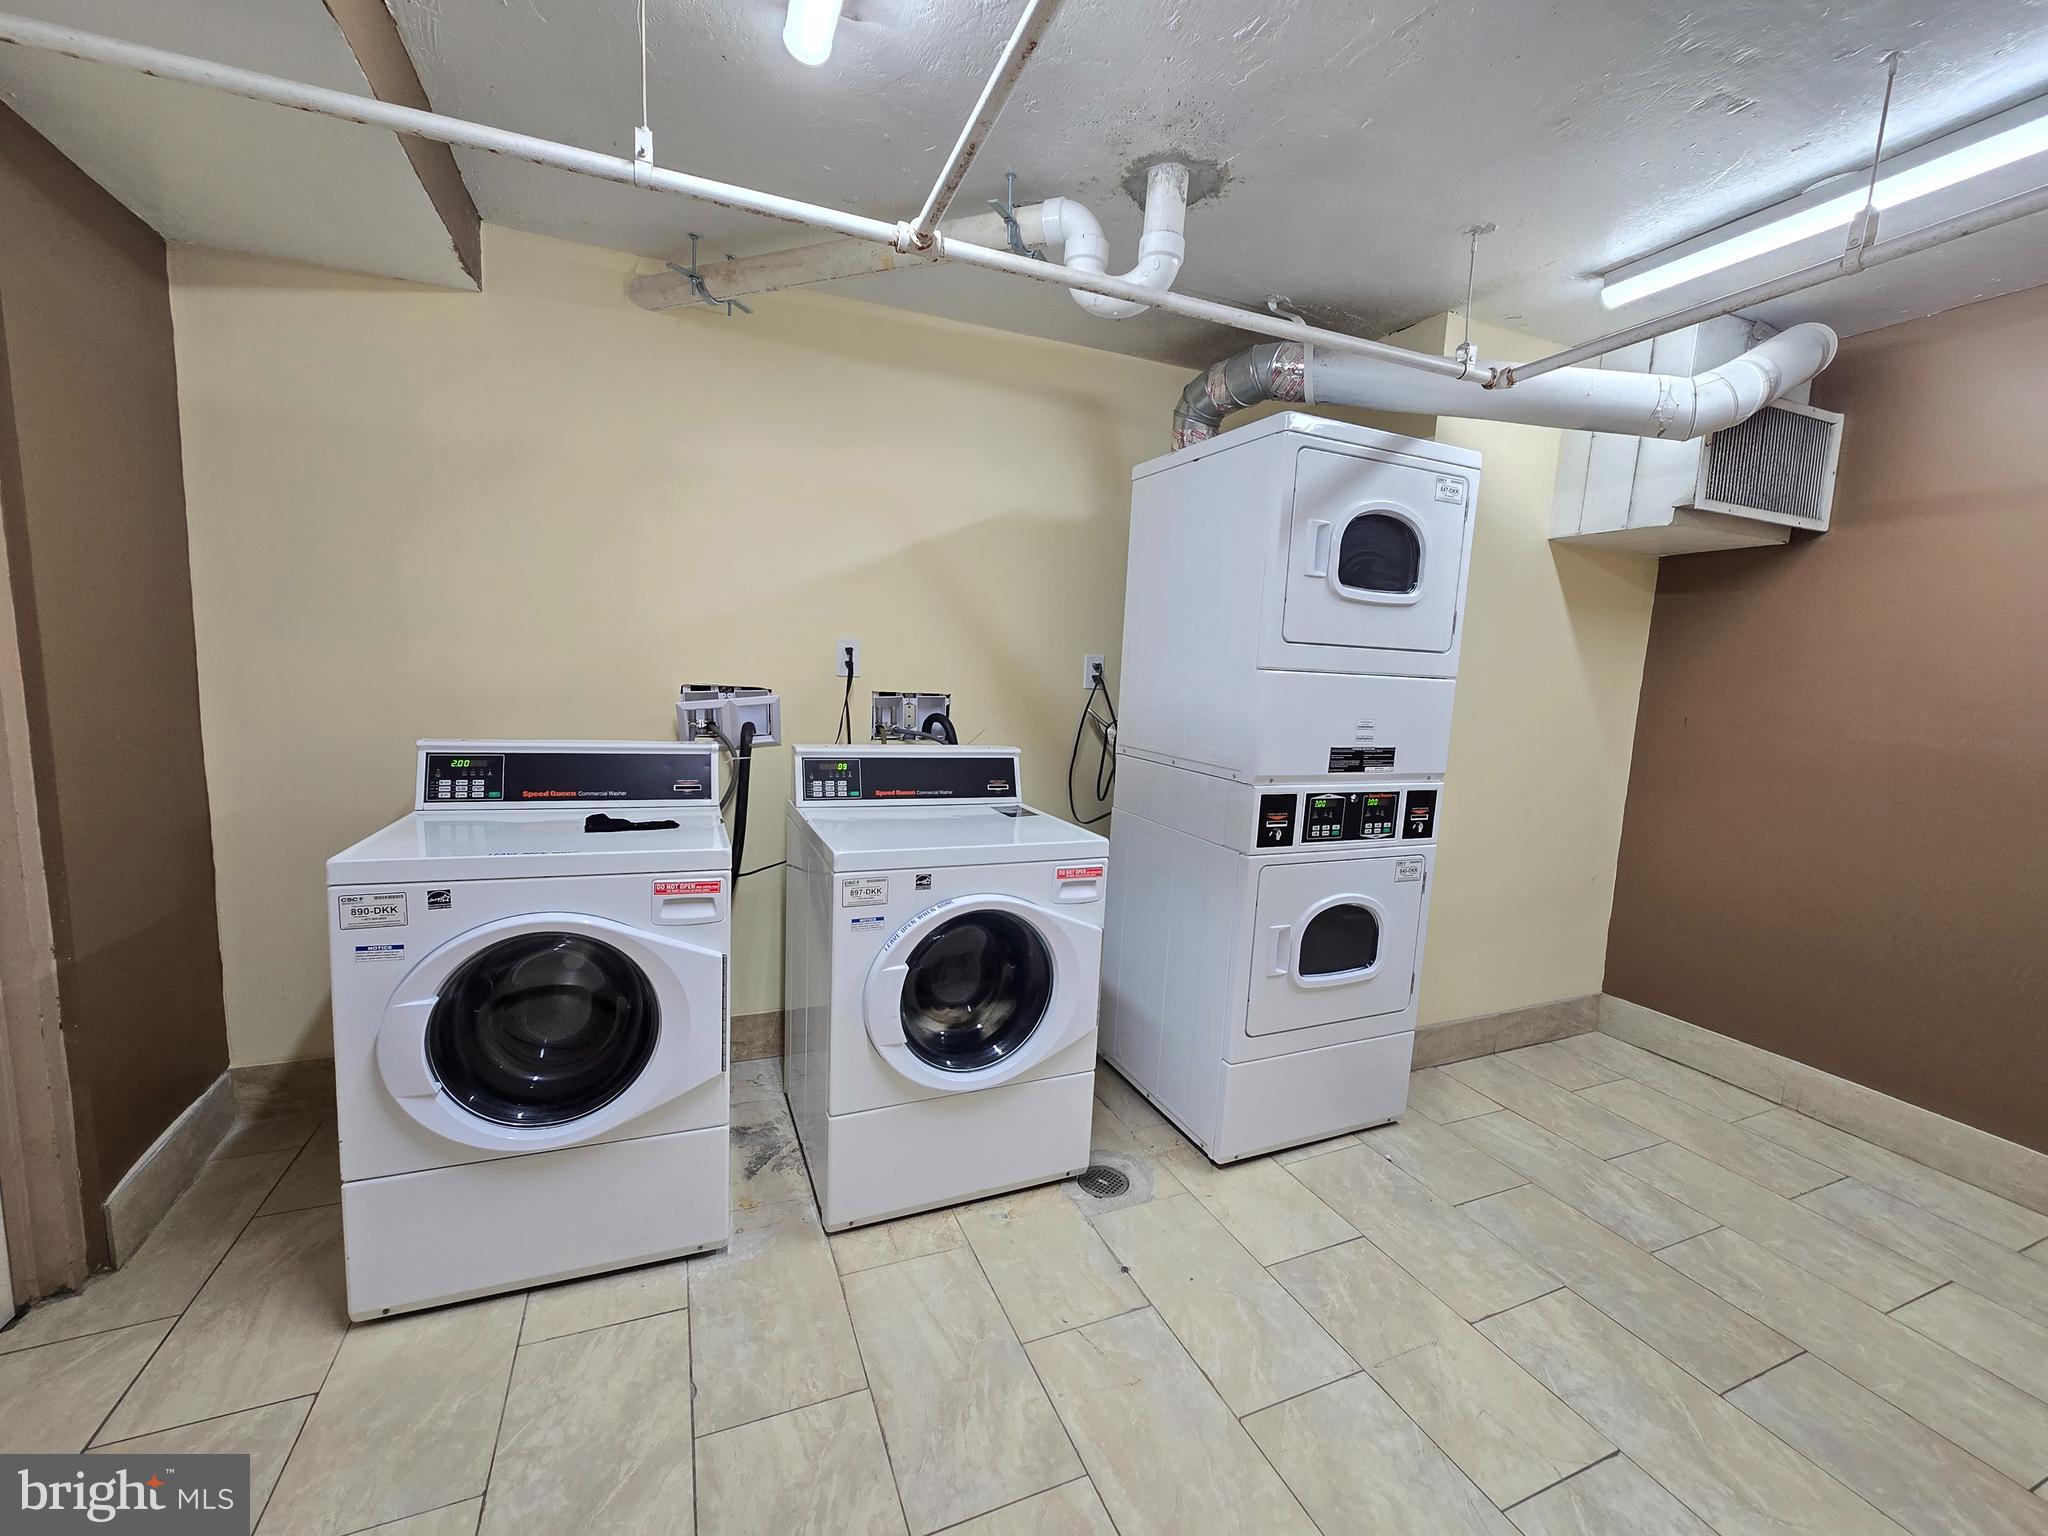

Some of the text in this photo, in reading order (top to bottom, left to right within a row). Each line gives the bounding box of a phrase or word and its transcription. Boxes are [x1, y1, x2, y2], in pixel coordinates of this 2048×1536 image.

[838, 763, 848, 771] 09
[522, 790, 549, 798] Speed
[850, 887, 882, 897] 897-DKK
[350, 905, 398, 916] 890-DKK
[883, 933, 901, 952] LEAVE
[900, 919, 917, 934] OPEN
[917, 907, 937, 920] WHEN
